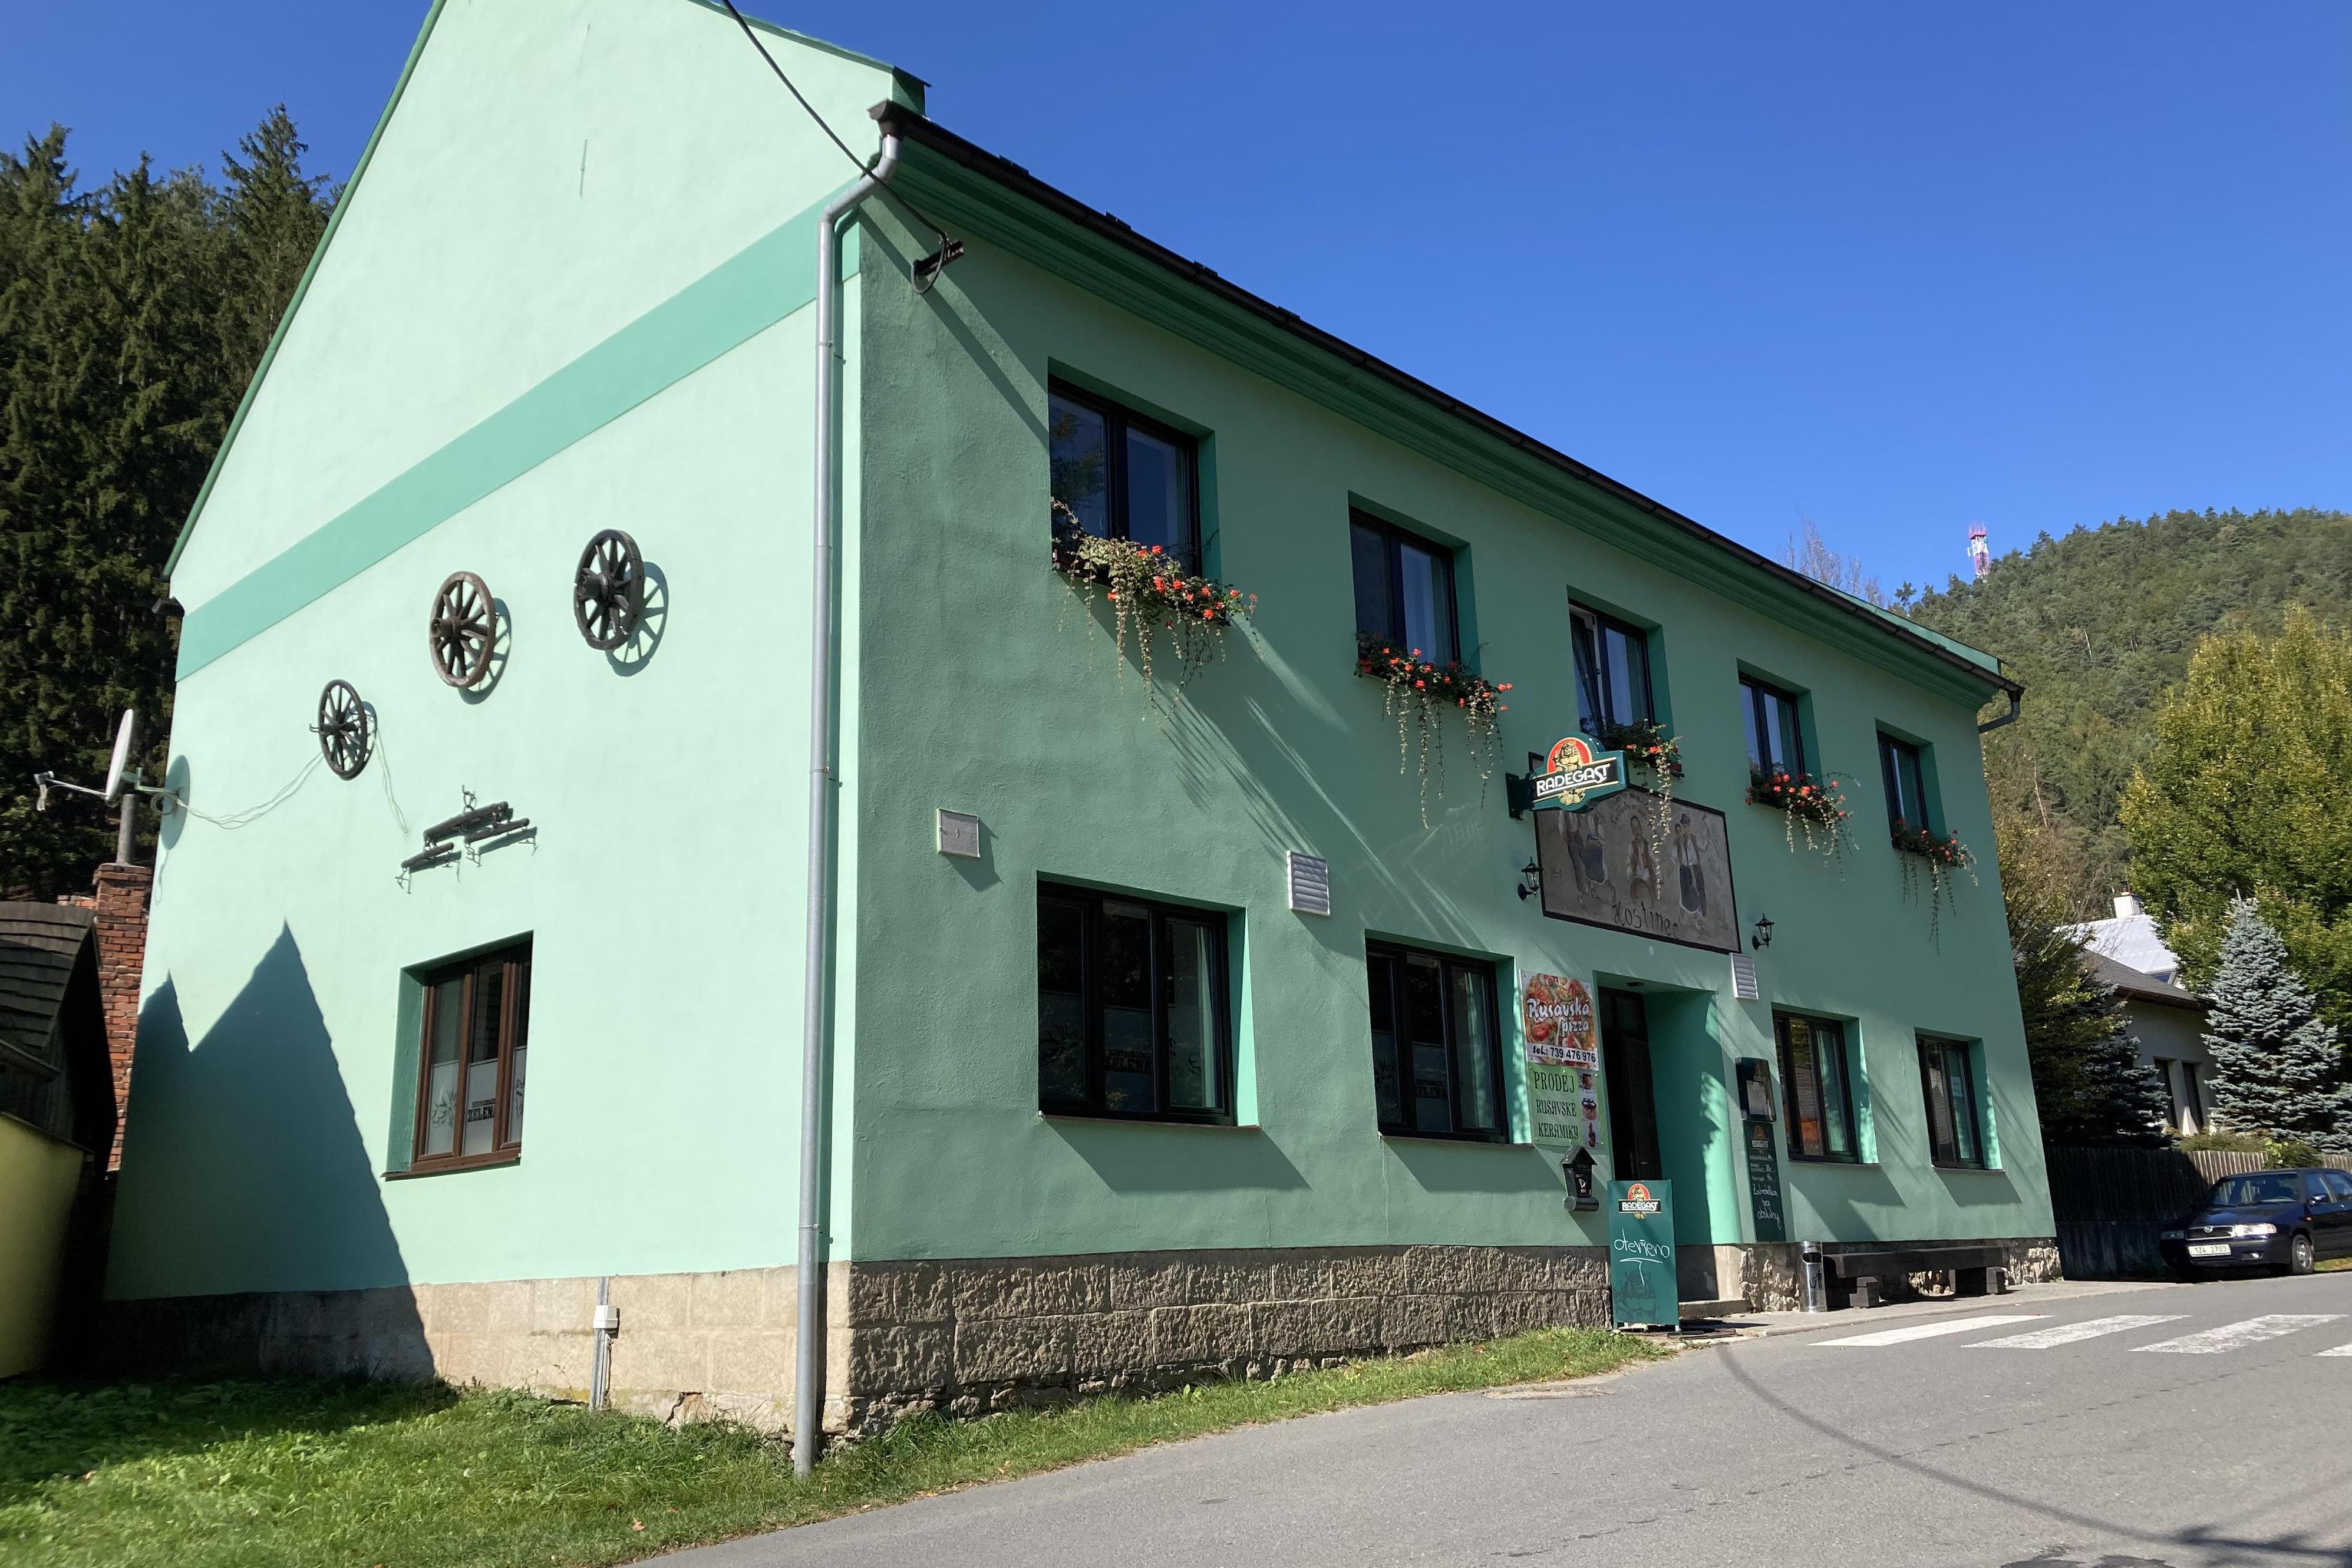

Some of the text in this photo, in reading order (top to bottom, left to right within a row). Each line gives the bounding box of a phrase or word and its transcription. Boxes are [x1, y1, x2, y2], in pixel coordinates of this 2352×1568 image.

[1536, 763, 1610, 797] RADEGAST
[1526, 998, 1590, 1019] Rusavská
[1561, 1018, 1589, 1037] pizza
[1550, 1047, 1563, 1058] 739
[1566, 1049, 1581, 1061] 476
[1582, 1051, 1596, 1062] 976
[1533, 1071, 1575, 1094] PRODEJ
[467, 1106, 494, 1123] ZELEN
[1536, 1099, 1577, 1117] RUSAVSKÉ
[1538, 1122, 1579, 1140] KERAMIKY
[1622, 1201, 1658, 1212] RADEGAST
[1614, 1228, 1670, 1259] otevřeno
